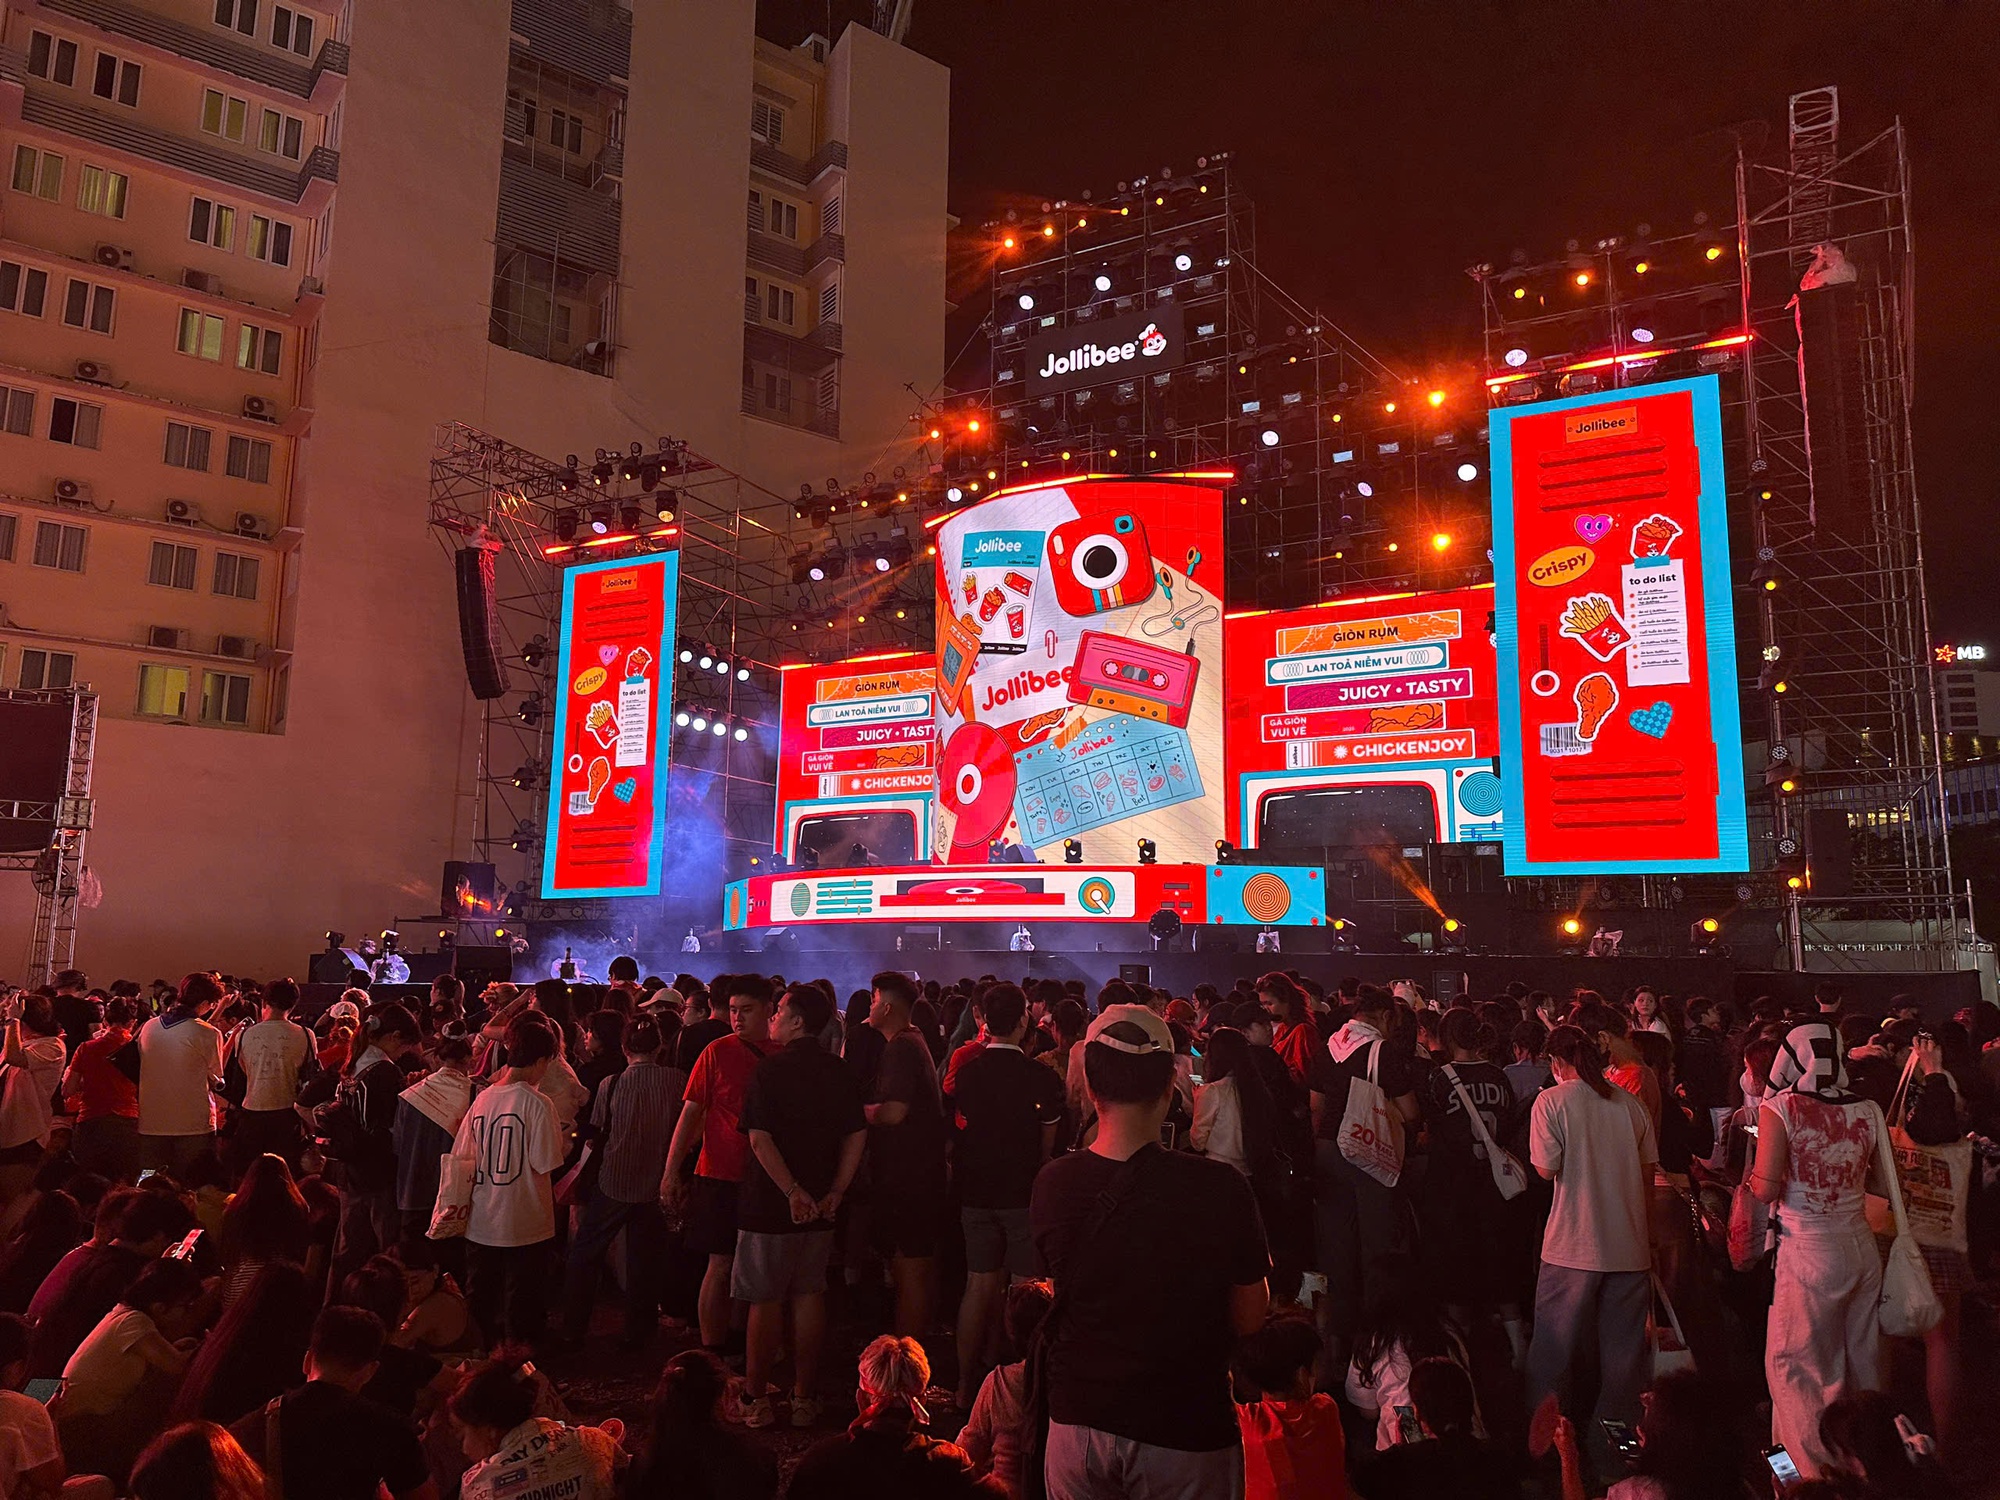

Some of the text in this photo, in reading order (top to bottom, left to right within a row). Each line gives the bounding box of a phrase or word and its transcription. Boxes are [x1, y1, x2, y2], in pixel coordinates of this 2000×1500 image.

[1039, 342, 1136, 378] Jollibee
[1576, 419, 1626, 433] Jollibee
[975, 537, 1022, 553] Jollibee
[1532, 552, 1587, 580] Crispy
[605, 578, 632, 588] Jollibee
[1629, 574, 1677, 585] to do list
[1333, 626, 1398, 642] GIÒN RỤM
[1957, 646, 1985, 660] MB
[1306, 664, 1328, 673] LAN
[1384, 656, 1403, 665] VUI
[575, 672, 604, 691] Crispy
[855, 681, 900, 692] GIÒN RỤM
[982, 666, 1075, 711] Jollibee
[1338, 678, 1464, 701] JUICY TASTY
[835, 710, 850, 718] LAN
[888, 705, 901, 713] VUI
[1269, 716, 1307, 727] GÀ GIÒN
[856, 728, 893, 742] JUICY
[1270, 727, 1290, 738] VUI
[1070, 735, 1115, 760] Jollibee
[1352, 738, 1467, 758] CHICKENJOY
[808, 763, 822, 771] VUI
[863, 774, 934, 790] CHICKENJO
[1131, 794, 1146, 806] Best
[1350, 1123, 1375, 1145] 20
[443, 1204, 469, 1221] 20
